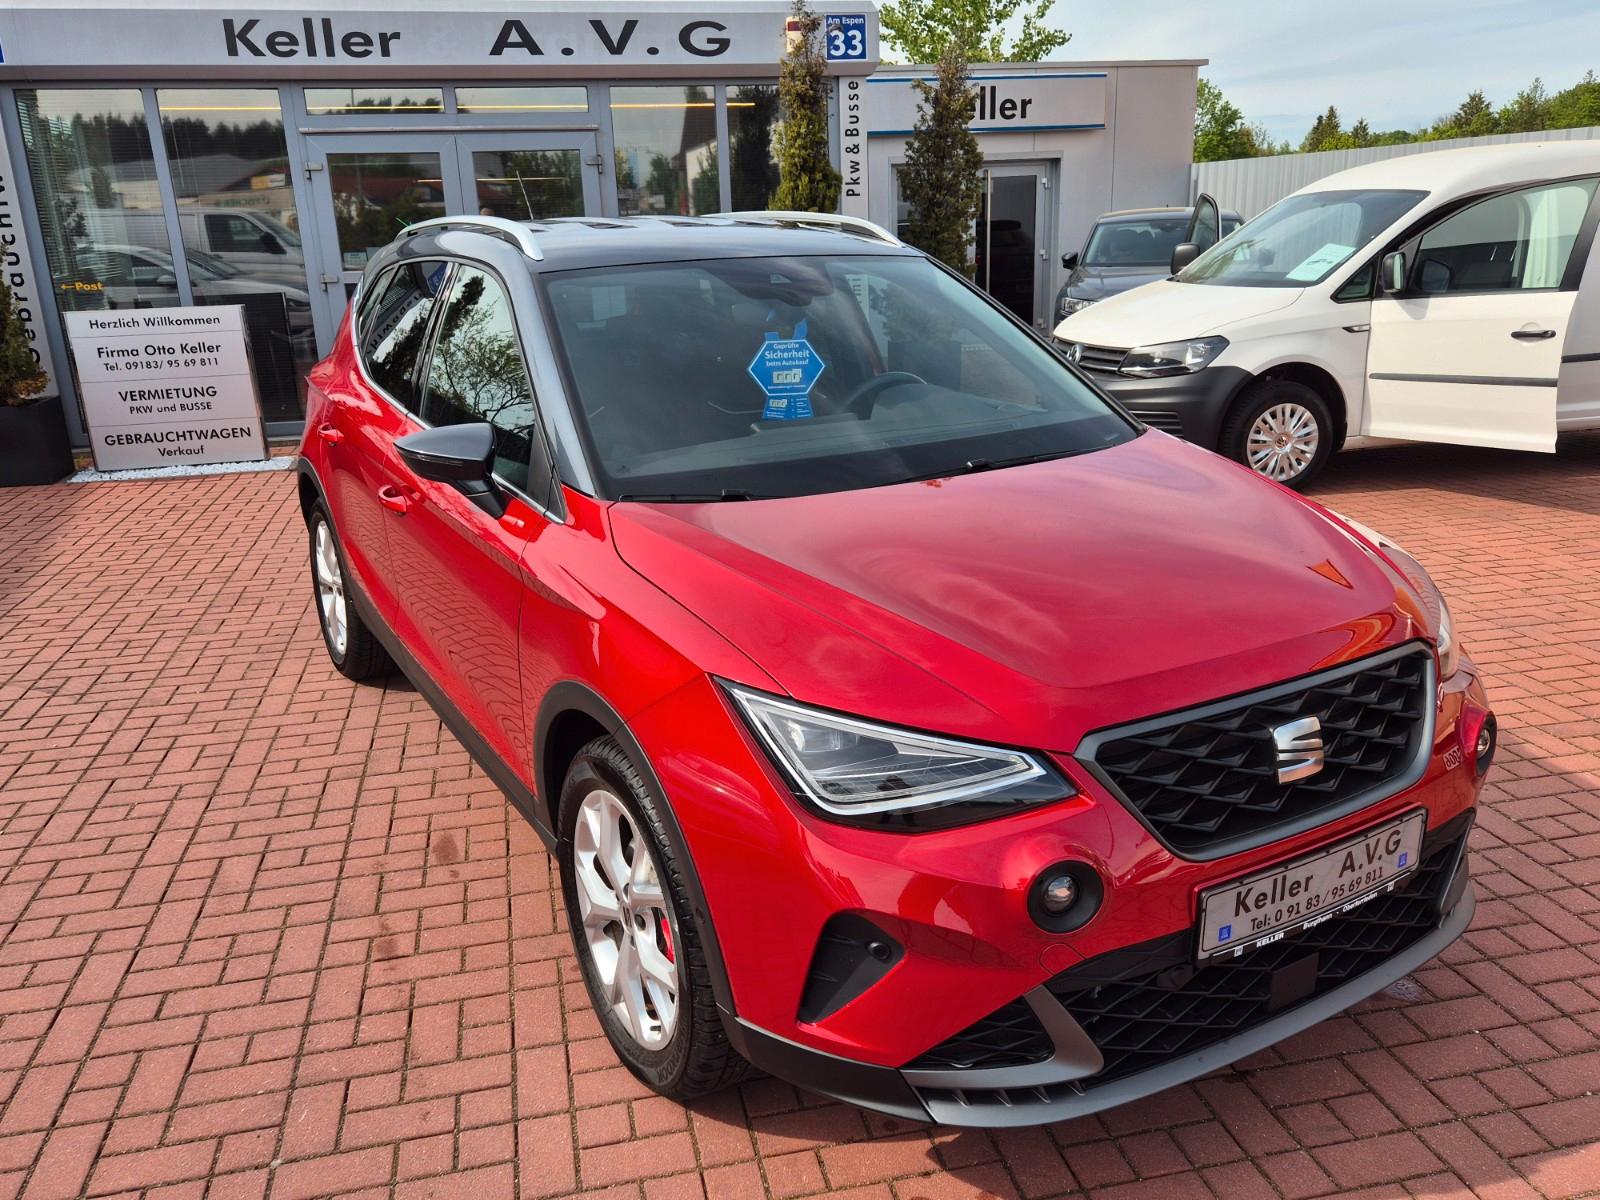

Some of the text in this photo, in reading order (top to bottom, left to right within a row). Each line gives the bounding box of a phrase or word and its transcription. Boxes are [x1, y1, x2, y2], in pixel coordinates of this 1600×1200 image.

[828, 16, 864, 26] Am Espen
[222, 17, 400, 58] Keller
[830, 30, 863, 57] 33
[845, 80, 861, 197] Pkw & Busse
[75, 281, 104, 291] Post
[89, 317, 221, 329] Herzlich Willkommen
[97, 341, 222, 358] Firma Otto Keller
[764, 349, 810, 360] Sicherheit
[104, 357, 219, 371] Tel. 09183/ 95 69 811
[119, 386, 217, 402] VERMIETUNG
[129, 402, 213, 415] PKW und BUSSE
[104, 427, 252, 446] GEBRAUCHTWAGEN
[157, 445, 205, 457] Verkauf
[1234, 829, 1402, 917] Keller A.V.G
[1250, 913, 1271, 931] Tel:
[1275, 909, 1283, 922] 0
[1287, 902, 1300, 918] 91
[1305, 894, 1320, 910] 83
[1331, 884, 1345, 899] 95
[1348, 876, 1362, 892] 69
[1365, 866, 1383, 884] 811
[1256, 932, 1284, 948] KELLER
